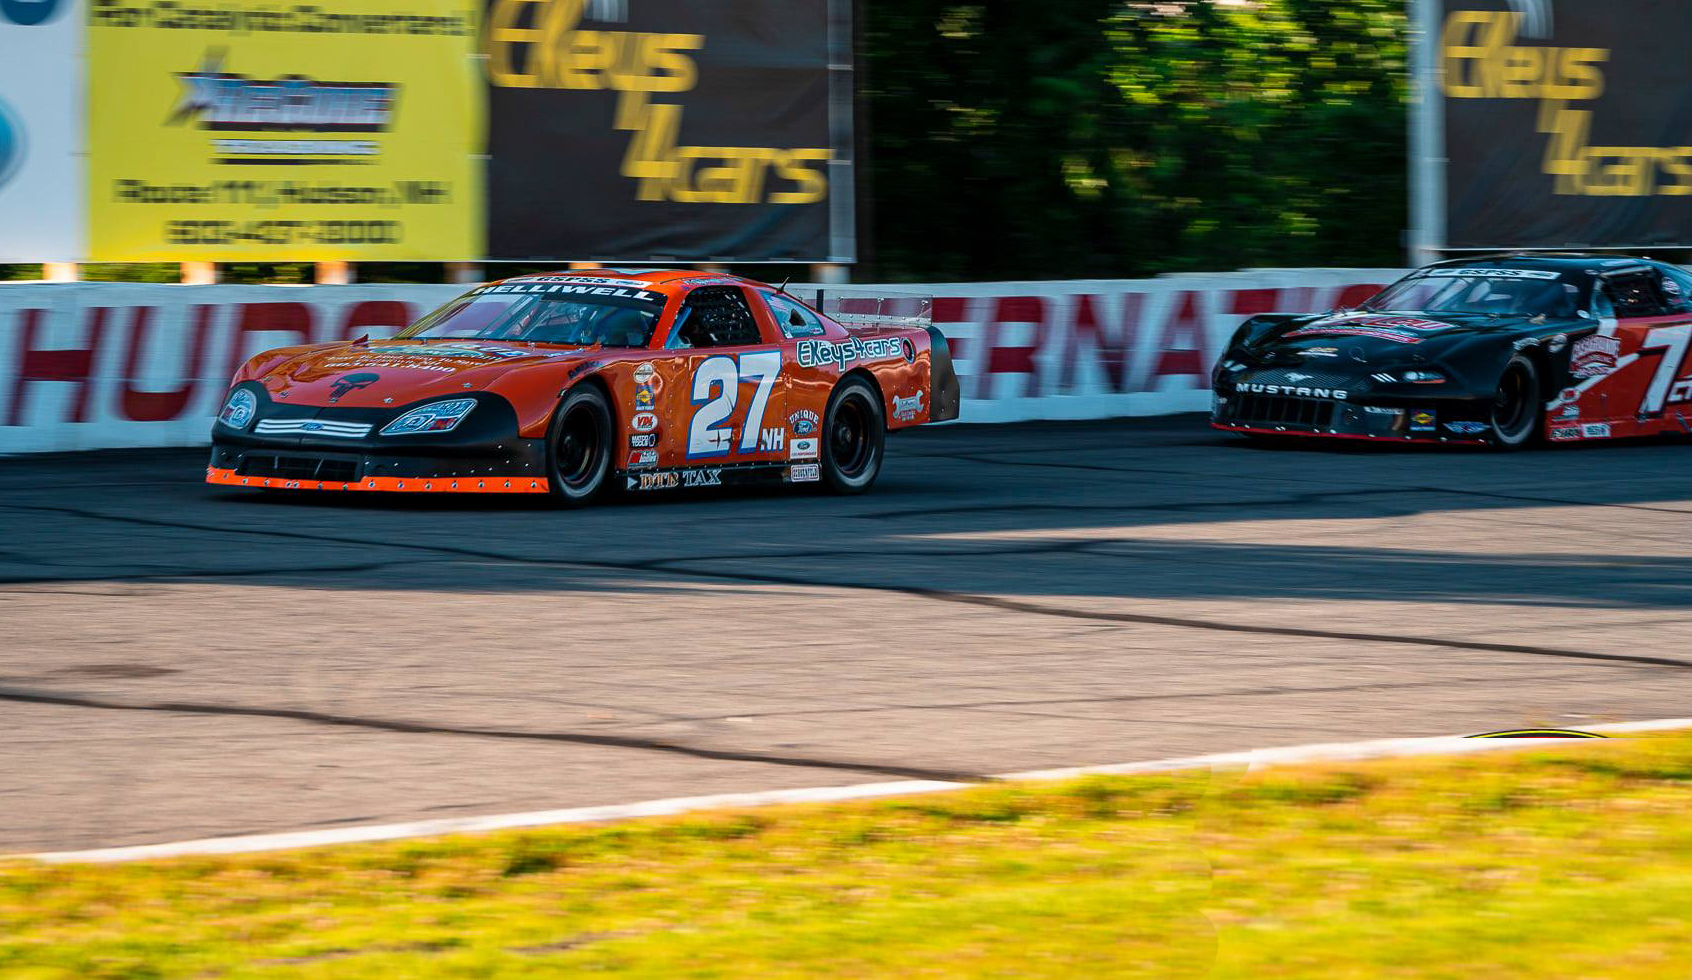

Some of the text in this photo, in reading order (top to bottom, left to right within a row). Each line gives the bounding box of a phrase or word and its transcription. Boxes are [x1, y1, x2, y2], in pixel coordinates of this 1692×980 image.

[473, 284, 655, 301] HELLIWELL
[1235, 383, 1348, 400] MUSTANG
[686, 350, 783, 459] 27
[789, 409, 820, 425] UNIQUE
[760, 427, 785, 452] NH
[682, 469, 722, 487] TAX
